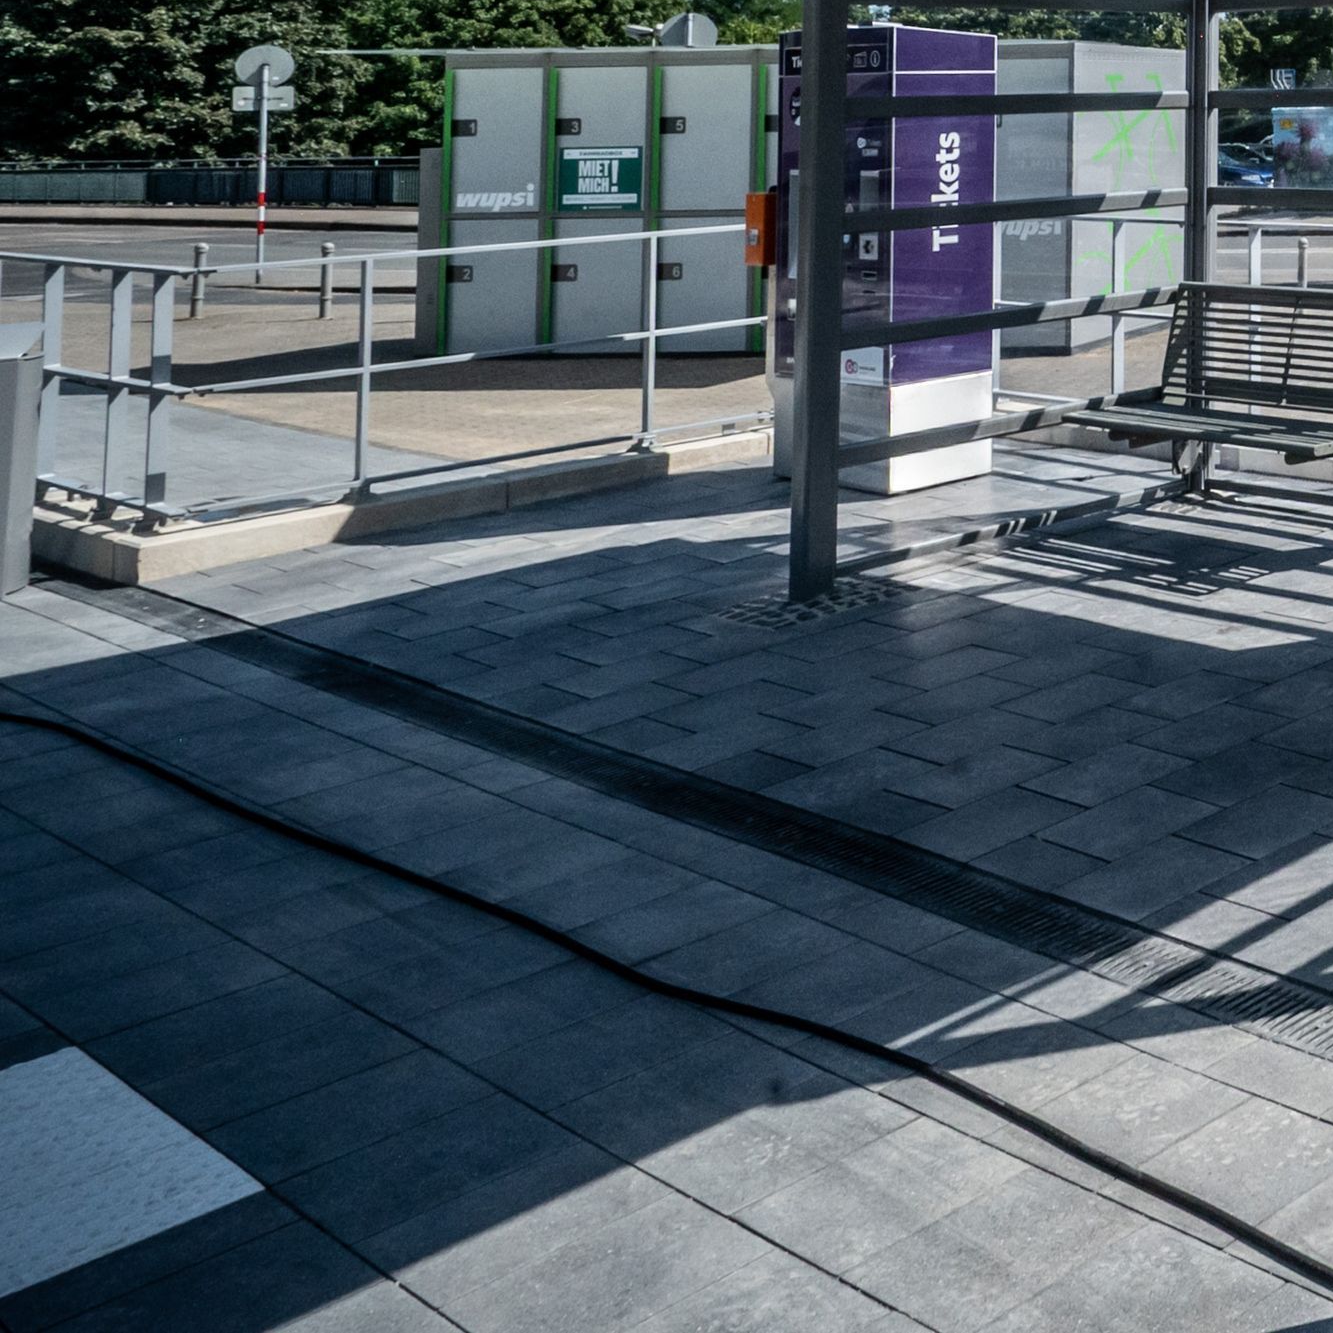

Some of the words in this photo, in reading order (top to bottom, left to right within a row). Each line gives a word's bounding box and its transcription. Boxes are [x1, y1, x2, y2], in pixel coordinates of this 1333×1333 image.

[469, 122, 476, 133] 1
[571, 121, 580, 133] 3
[675, 119, 685, 131] 5
[578, 159, 611, 177] MIET
[456, 183, 535, 212] wupsi
[930, 131, 961, 252] Tkets
[463, 269, 471, 280] 2
[566, 268, 576, 279] 4
[672, 267, 680, 278] 6
